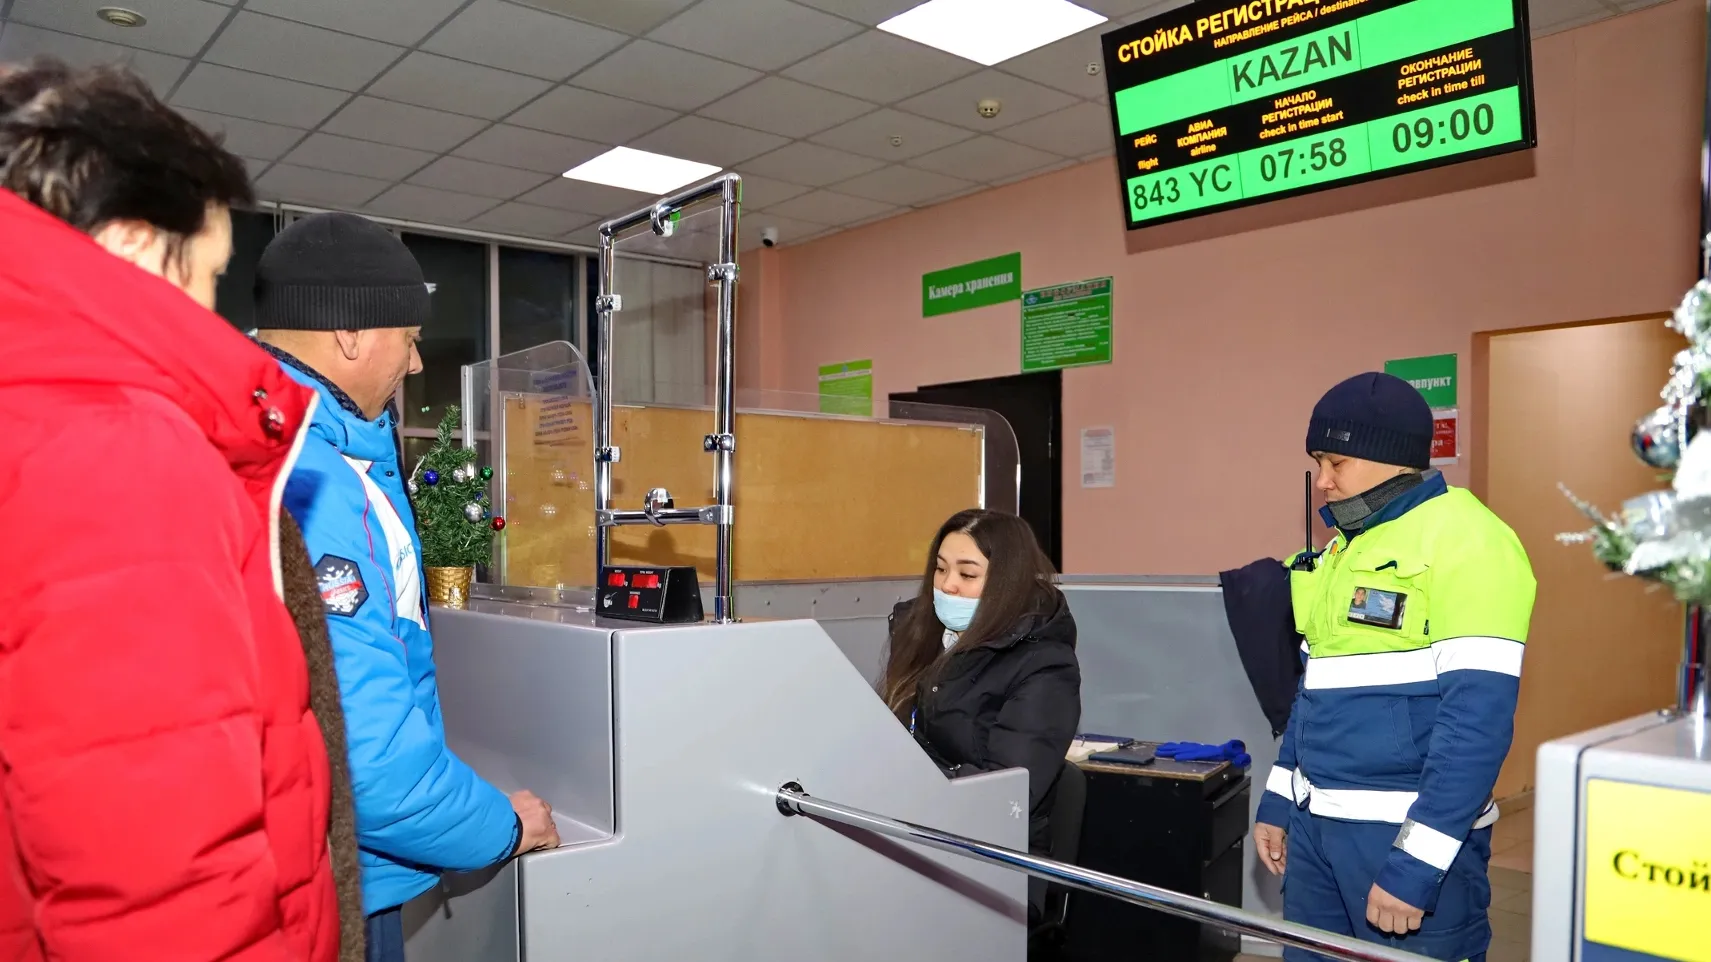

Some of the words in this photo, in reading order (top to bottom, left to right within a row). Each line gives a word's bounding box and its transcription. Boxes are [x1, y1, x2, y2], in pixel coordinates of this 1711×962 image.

[1118, 24, 1193, 63] СТОЙКА
[1213, 20, 1279, 49] НАПРАВЛЕНИЕ
[1281, 10, 1313, 28] РЕЙСА
[1232, 31, 1352, 93] KAZAN
[1398, 59, 1482, 89] РЕГИСТРАЦИИ
[1400, 48, 1474, 76] ОКОНЧАНИЕ
[1274, 90, 1317, 109] НАЧАЛО
[1397, 89, 1429, 105] check
[1431, 86, 1441, 97] in
[1444, 80, 1468, 93] time
[1470, 74, 1485, 87] till
[1259, 126, 1286, 139] check
[1288, 122, 1297, 132] in
[1298, 118, 1319, 129] time
[1321, 111, 1344, 124] start
[1262, 98, 1333, 124] РЕГИСТРАЦИИ
[1134, 133, 1158, 148] РЕЙС
[1177, 126, 1227, 147] КОМПАНИЯ
[1188, 119, 1213, 134] АВИА
[1392, 103, 1494, 153] 09:00
[1190, 142, 1217, 156] airline
[1260, 137, 1347, 182] 07:58
[1137, 157, 1159, 170] flight
[1133, 177, 1181, 210] 843
[1189, 164, 1232, 197] YC
[928, 284, 964, 300] Камера
[965, 272, 1014, 294] хранения
[1406, 376, 1452, 391] авпункт
